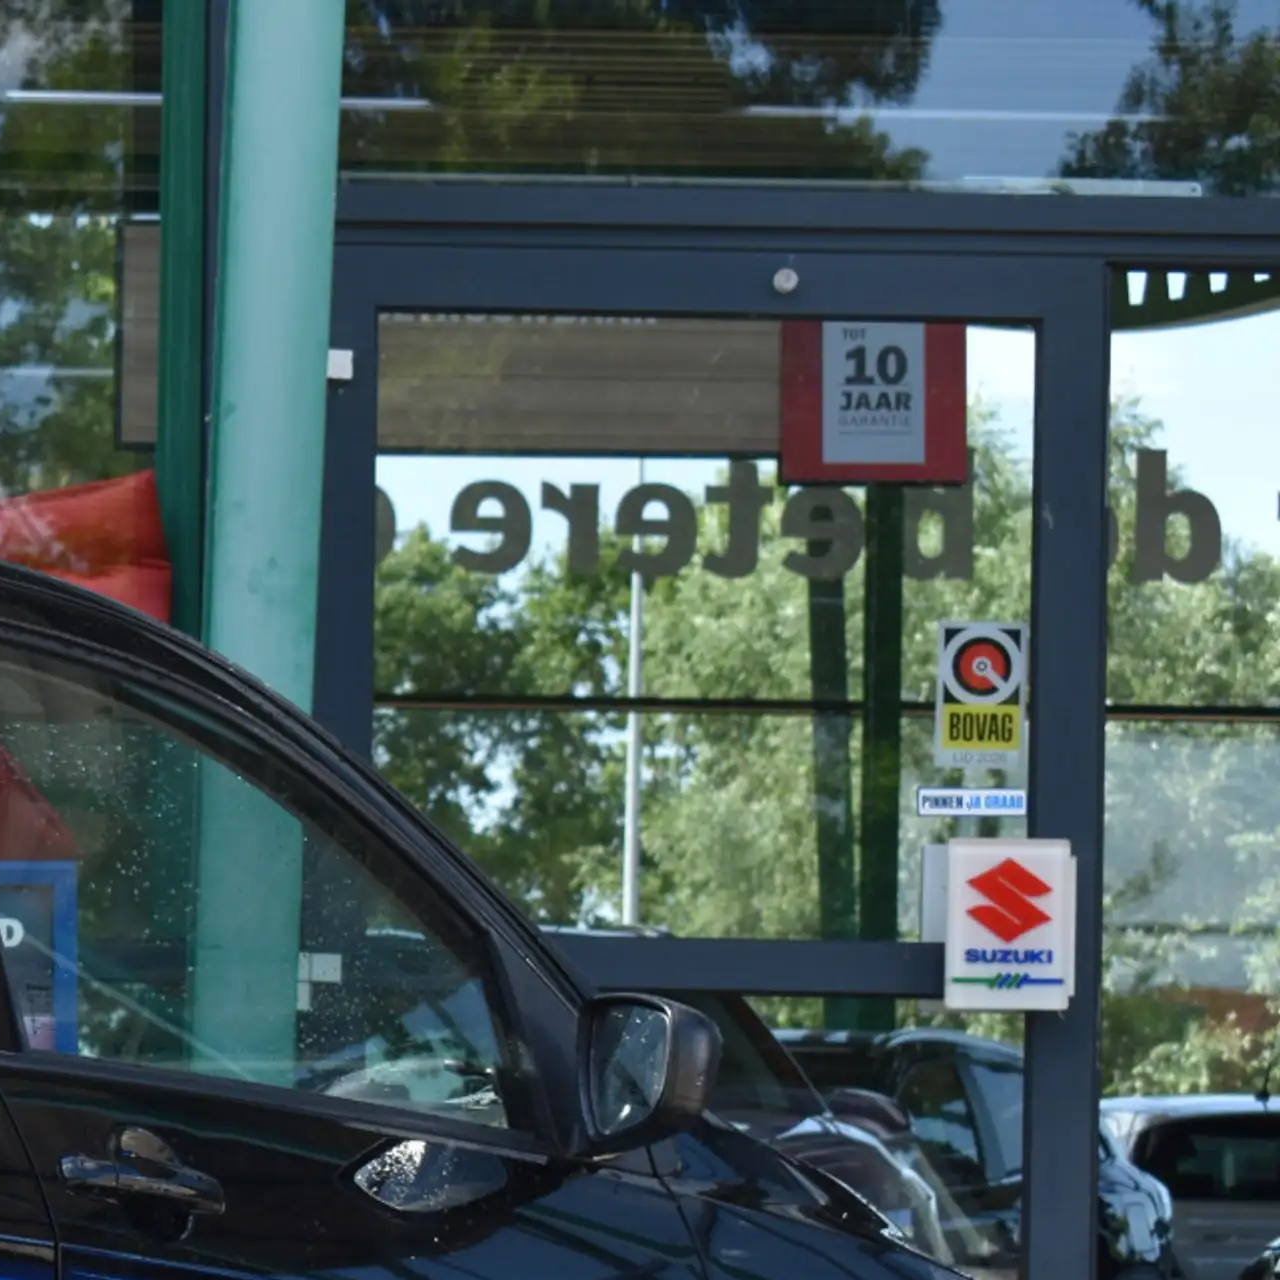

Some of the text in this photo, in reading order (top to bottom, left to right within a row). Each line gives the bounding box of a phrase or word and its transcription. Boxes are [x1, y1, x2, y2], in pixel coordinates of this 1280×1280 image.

[845, 344, 908, 385] 10
[840, 391, 912, 411] JAAR
[948, 711, 1013, 743] BOVAG
[964, 948, 1053, 964] SUZUKI
